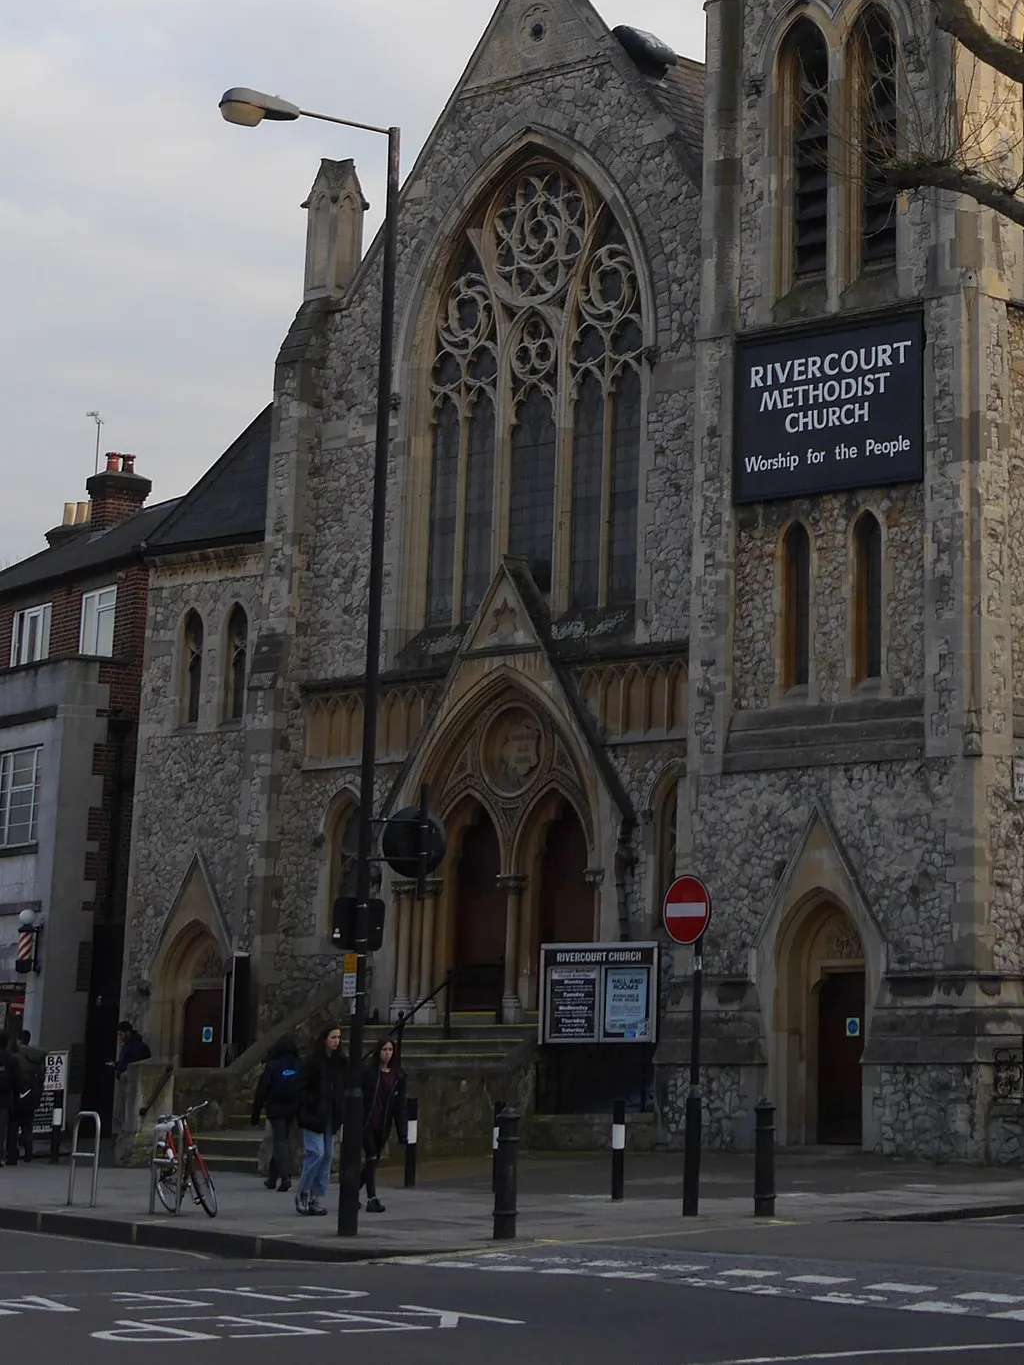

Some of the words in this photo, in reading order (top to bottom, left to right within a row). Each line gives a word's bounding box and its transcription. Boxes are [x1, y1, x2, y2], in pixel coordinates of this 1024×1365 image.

[750, 340, 912, 388] RIVERCOURT
[759, 372, 890, 412] METHODIST
[785, 402, 869, 433] CHURCH
[745, 451, 799, 473] Worship
[807, 448, 826, 465] for
[835, 444, 858, 462] the
[866, 435, 911, 457] People
[557, 951, 607, 962] RIVERCOURT
[608, 950, 642, 962] CHURCH
[89, 1304, 527, 1342] KEEP
